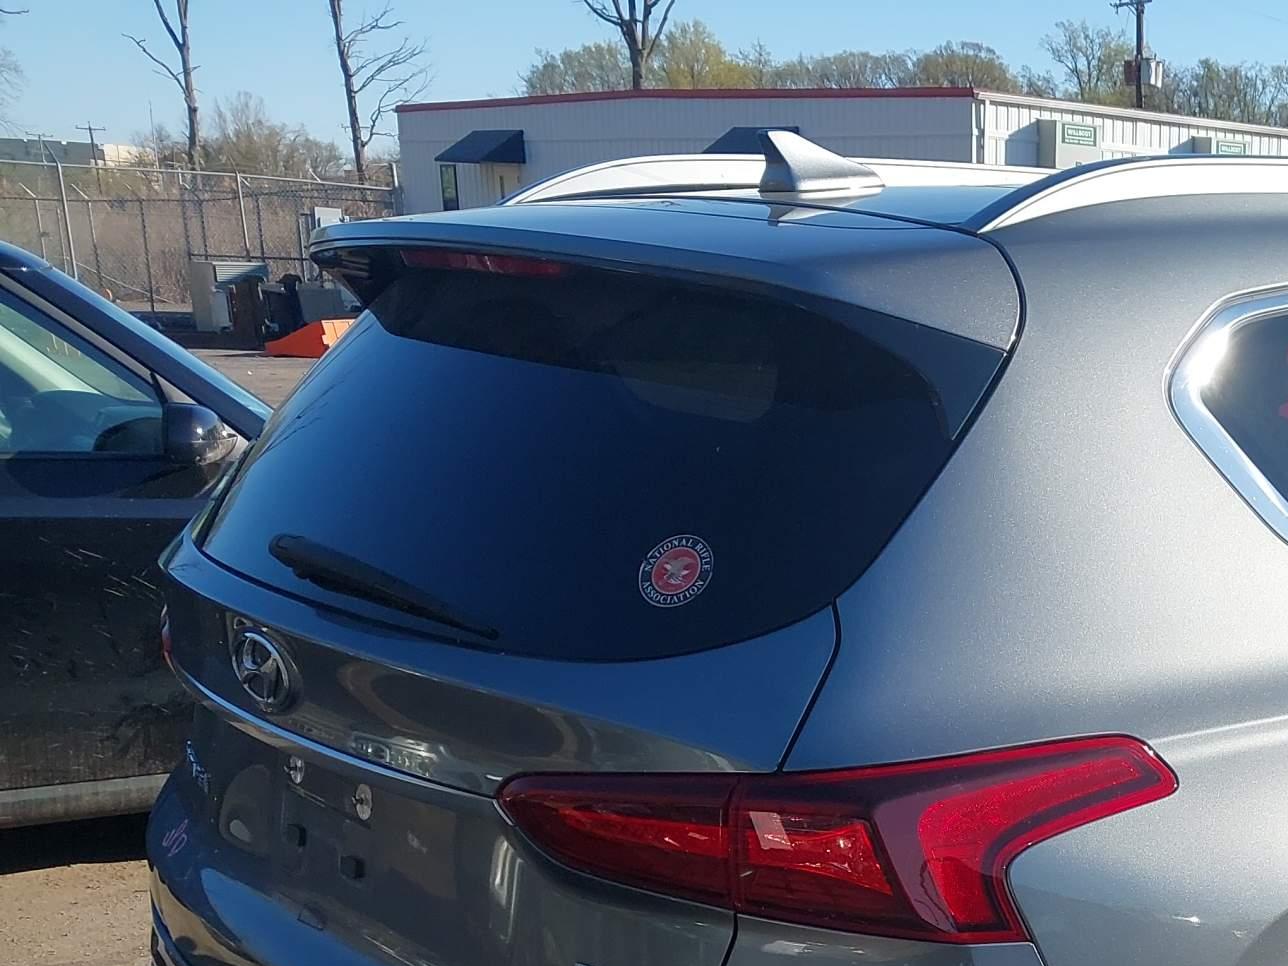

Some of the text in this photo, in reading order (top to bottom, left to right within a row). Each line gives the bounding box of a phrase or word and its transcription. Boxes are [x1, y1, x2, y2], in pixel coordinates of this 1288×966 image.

[1067, 128, 1091, 138] WILLSCOT
[644, 537, 711, 573] NATIONAL RIFLE
[641, 578, 705, 604] ASSOCIATION
